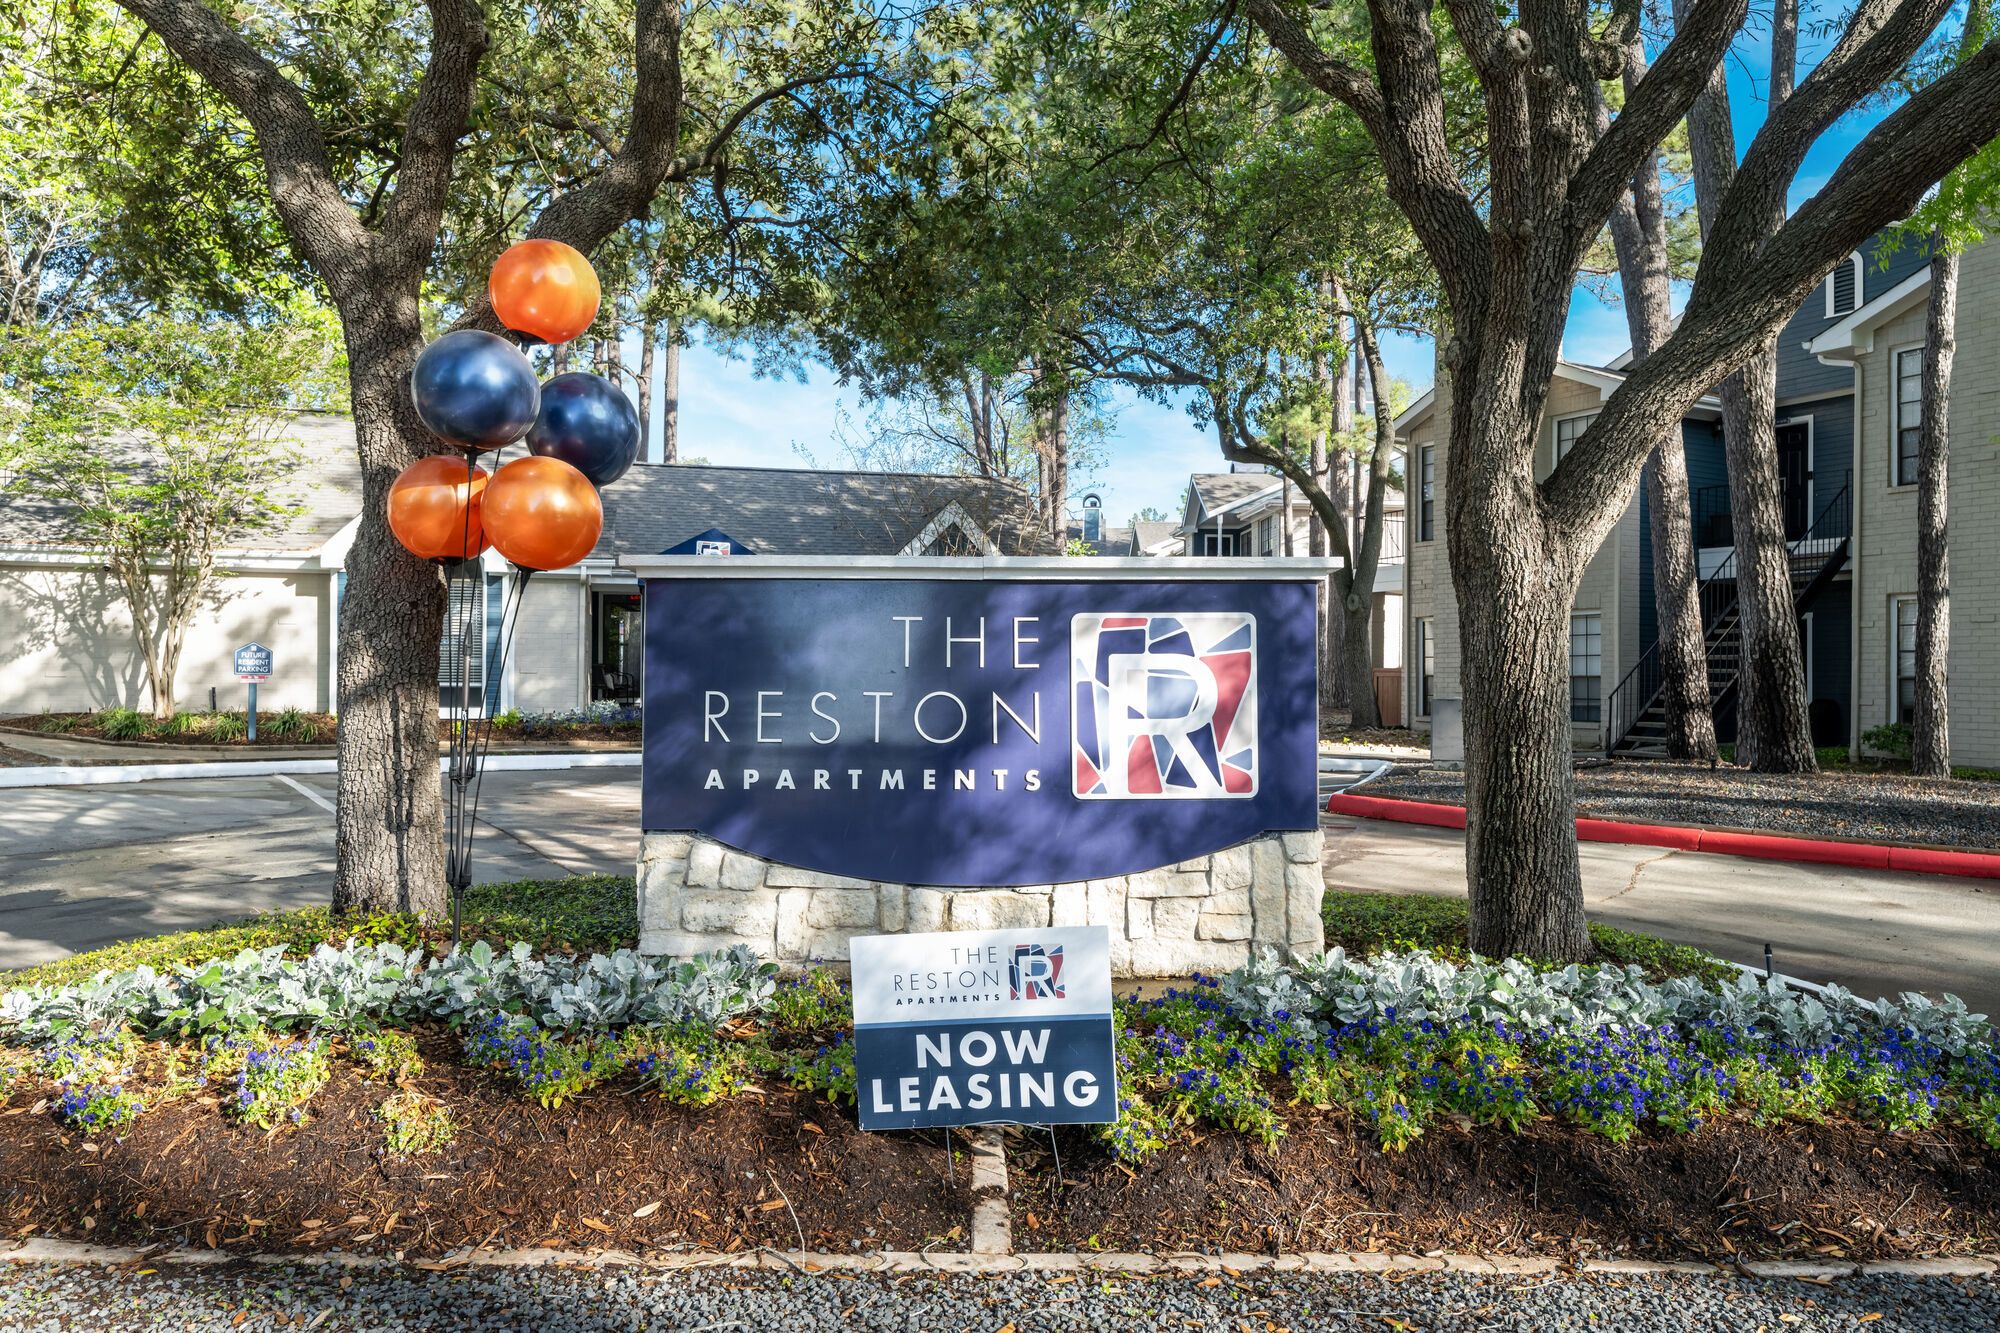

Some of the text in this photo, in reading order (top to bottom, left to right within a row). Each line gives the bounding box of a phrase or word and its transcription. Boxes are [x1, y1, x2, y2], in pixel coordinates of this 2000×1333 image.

[893, 616, 1040, 668] THE
[704, 690, 1040, 744] RESTON
[704, 769, 1041, 791] APARTMENTS
[951, 946, 998, 964] THE
[894, 970, 999, 991] RESTON
[896, 994, 1000, 1006] APARTMENTS
[915, 1029, 1051, 1068] NOW
[872, 1070, 1099, 1113] LEASING
